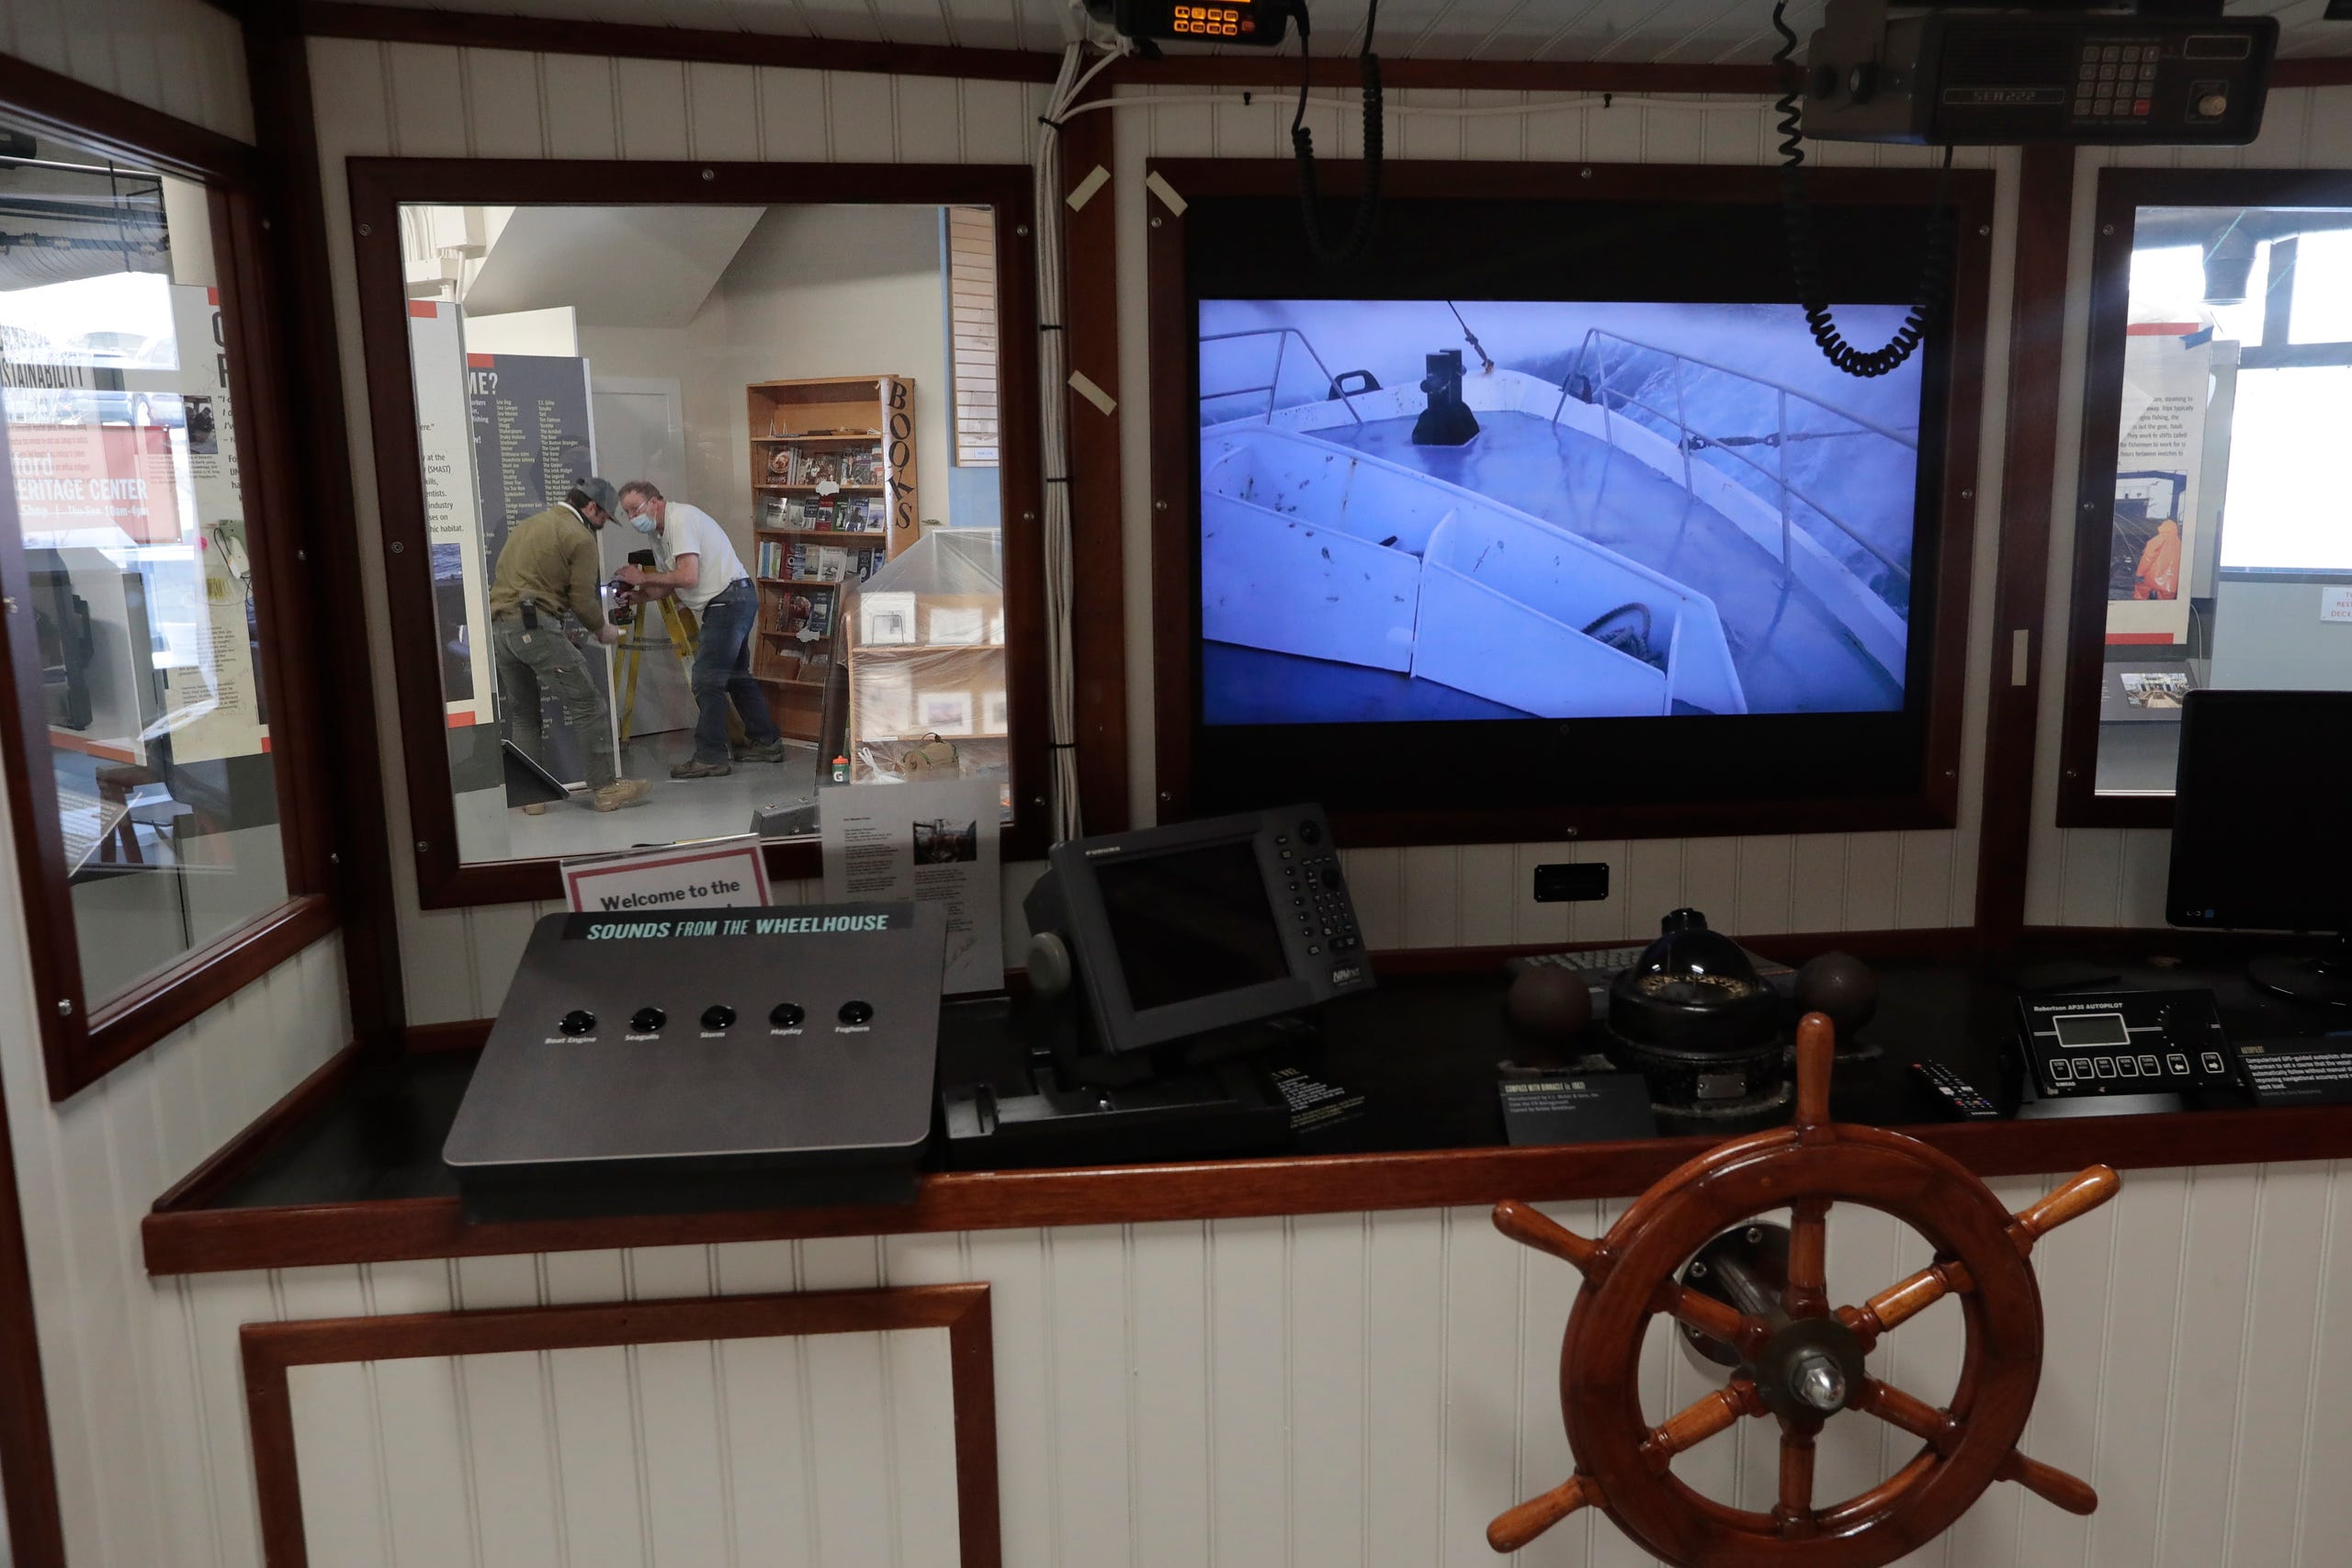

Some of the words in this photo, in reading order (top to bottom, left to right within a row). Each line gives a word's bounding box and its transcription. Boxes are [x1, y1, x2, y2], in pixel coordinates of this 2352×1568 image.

[887, 380, 915, 529] BOOKS
[428, 465, 451, 474] (SMAST)
[88, 479, 147, 501] CENTER
[833, 771, 843, 782] G
[600, 888, 686, 912] Welcome
[689, 884, 708, 898] to
[711, 880, 740, 895] the
[587, 922, 672, 941] SOUNDS
[674, 920, 718, 938] FROM
[723, 919, 750, 935] THE
[755, 914, 889, 934] WHEELHOUSE
[770, 1028, 803, 1036] Mayday
[835, 1026, 870, 1034] Foghorn
[567, 1036, 597, 1044] Engine
[625, 1033, 660, 1042] Seagulls
[2240, 1045, 2264, 1054] AUTOPILOT
